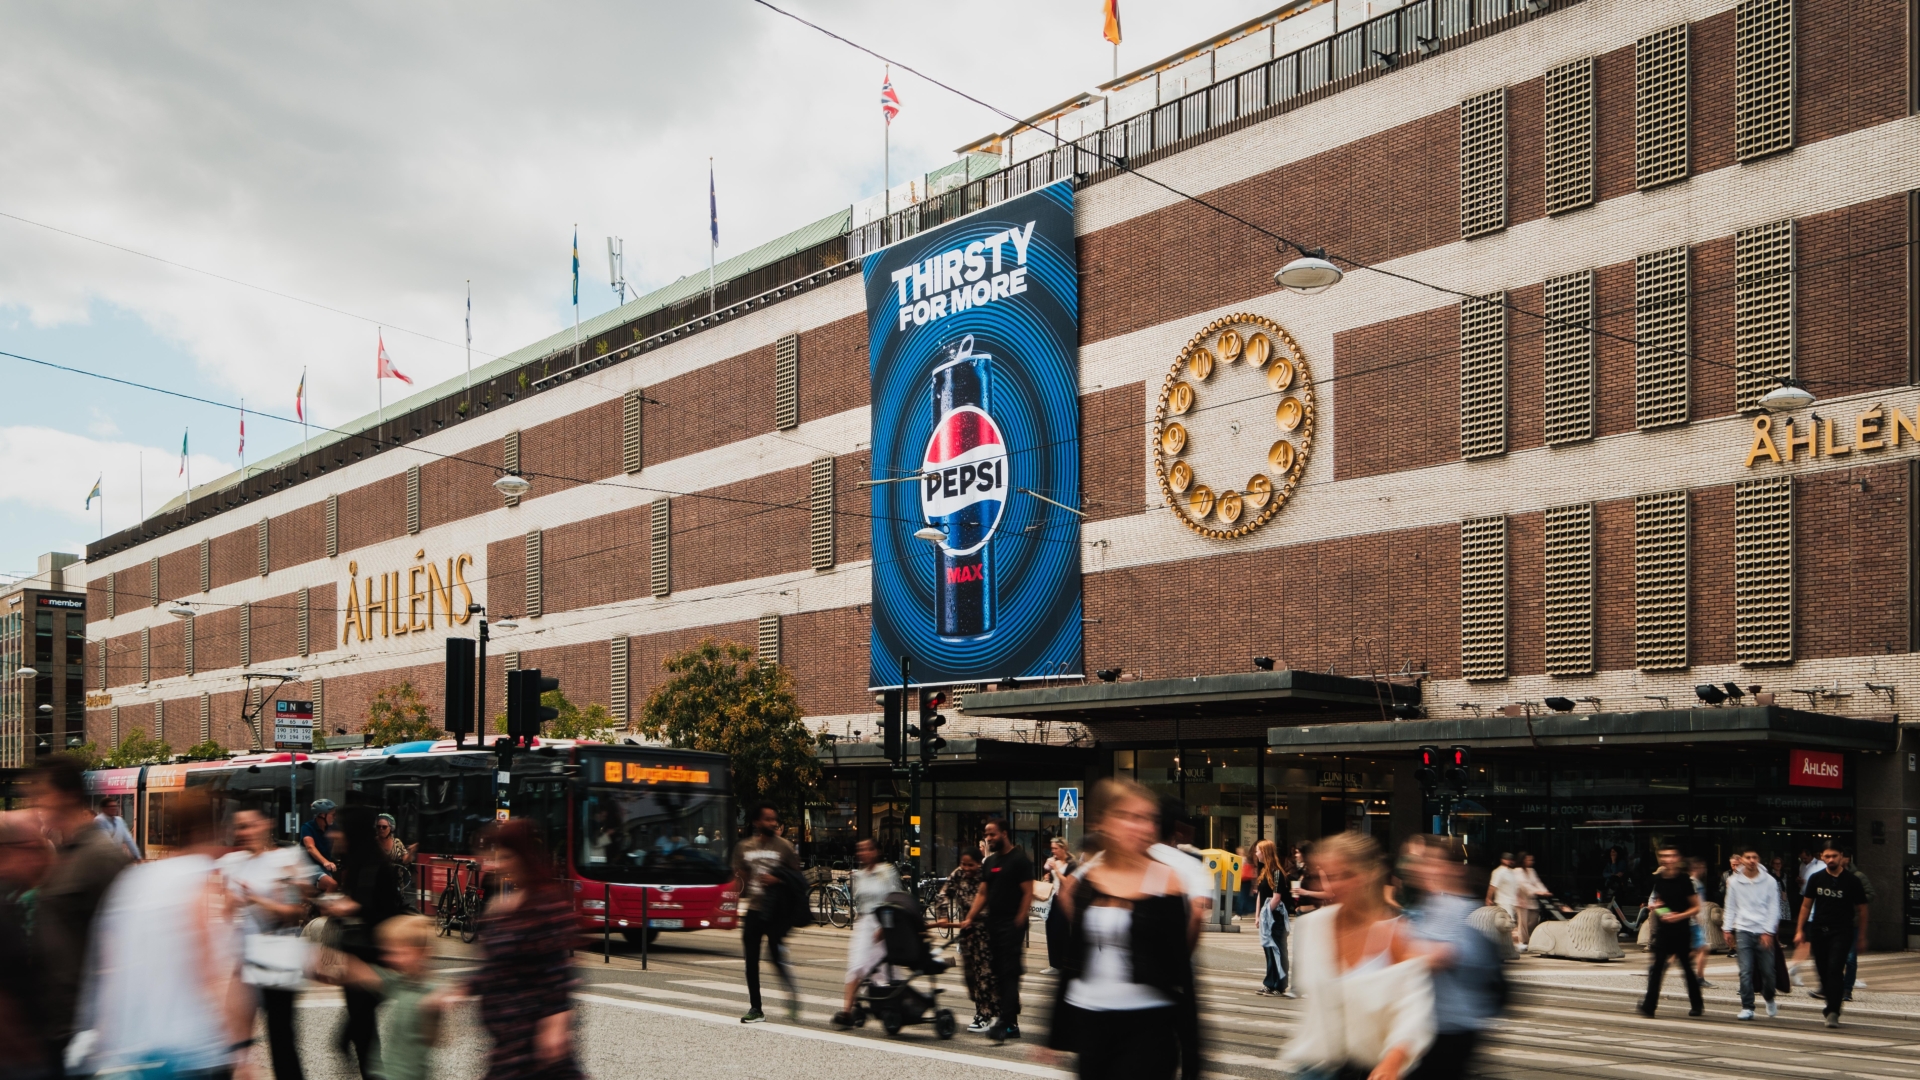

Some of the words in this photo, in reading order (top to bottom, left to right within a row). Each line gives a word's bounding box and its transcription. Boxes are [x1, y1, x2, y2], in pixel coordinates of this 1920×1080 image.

[891, 220, 1036, 305] THIRSTY
[900, 294, 947, 332] FOR
[951, 267, 1027, 314] MORE
[1222, 333, 1239, 358] 12
[1195, 352, 1209, 377] 11
[1275, 362, 1287, 388] 2
[1174, 386, 1190, 410] 10
[1284, 402, 1297, 428] 3
[1169, 427, 1181, 452] 9
[1744, 402, 1920, 467] ÅHLÉN
[1275, 443, 1287, 468] 4
[926, 458, 1002, 502] PEPSI
[1175, 465, 1185, 489] 8
[1197, 490, 1207, 512] 7
[1254, 480, 1264, 504] 5
[1224, 495, 1235, 519] 6
[946, 563, 983, 584] MAX
[342, 549, 473, 644] ÅHLÉNS
[290, 703, 296, 711] N
[1803, 758, 1839, 777] ÅHLÉNS
[1766, 797, 1824, 808] T-Centralen
[1817, 887, 1843, 898] BOSS
